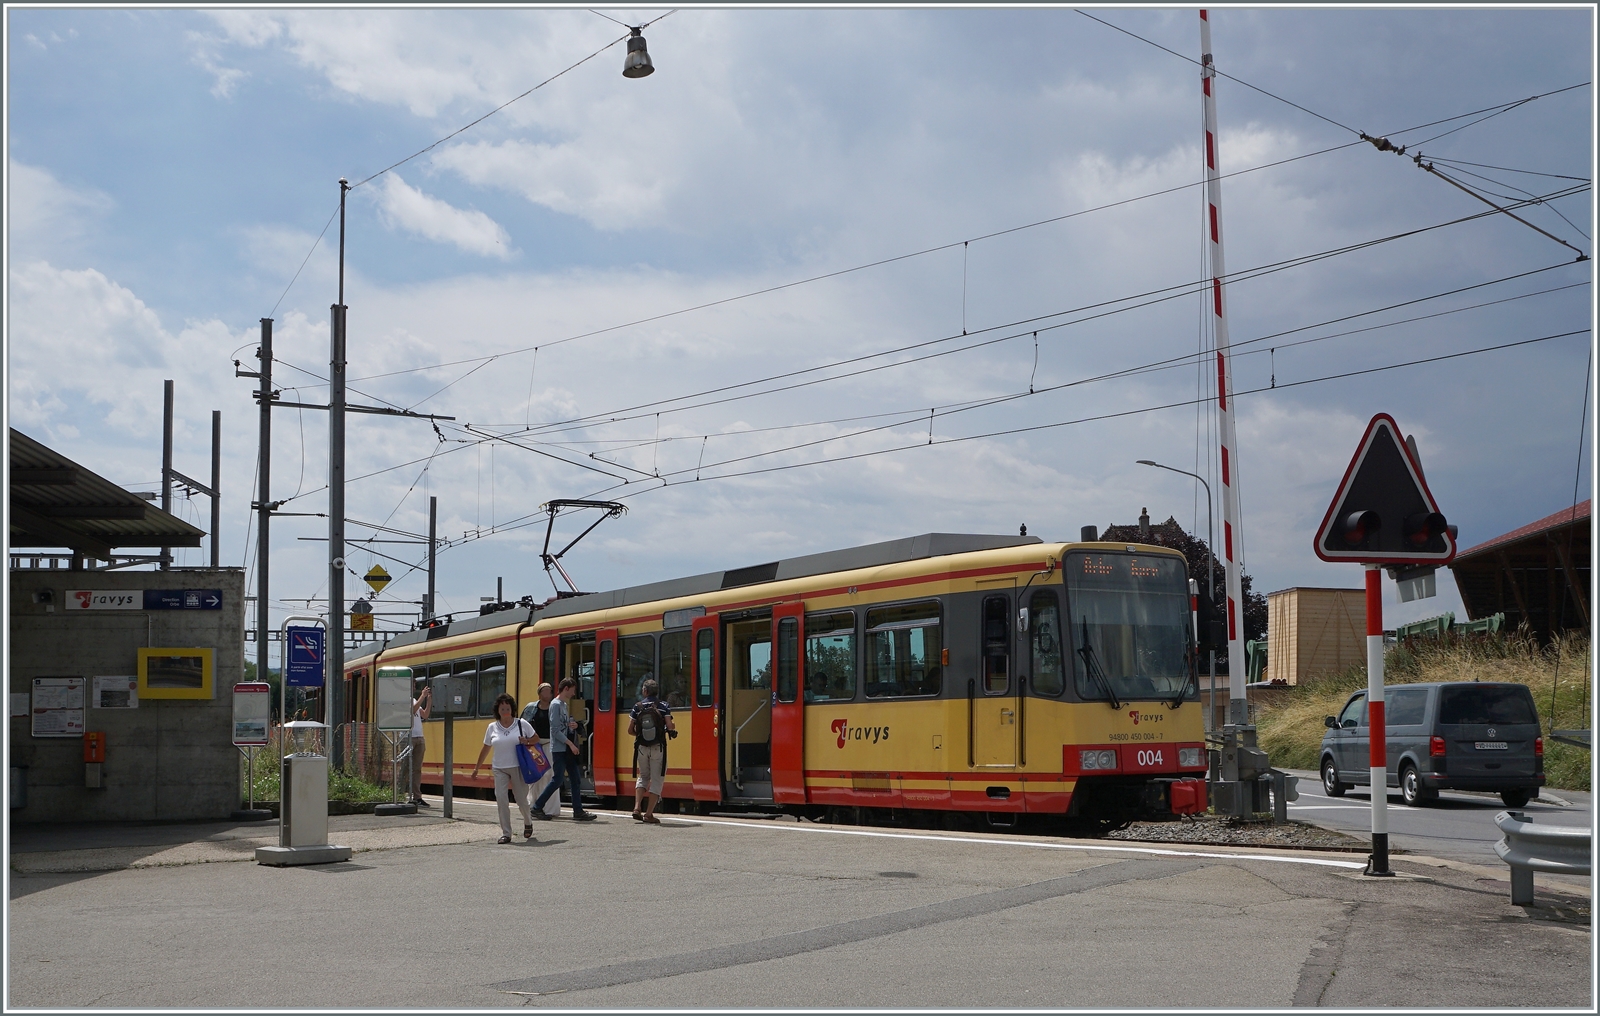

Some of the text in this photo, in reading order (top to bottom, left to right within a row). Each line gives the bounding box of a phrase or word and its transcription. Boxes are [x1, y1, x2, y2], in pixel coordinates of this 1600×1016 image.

[80, 592, 134, 607] travys
[1132, 711, 1163, 724] travys
[835, 719, 890, 747] travys
[1109, 733, 1129, 741] 94800
[1131, 733, 1142, 741] 450
[1138, 750, 1163, 766] 004
